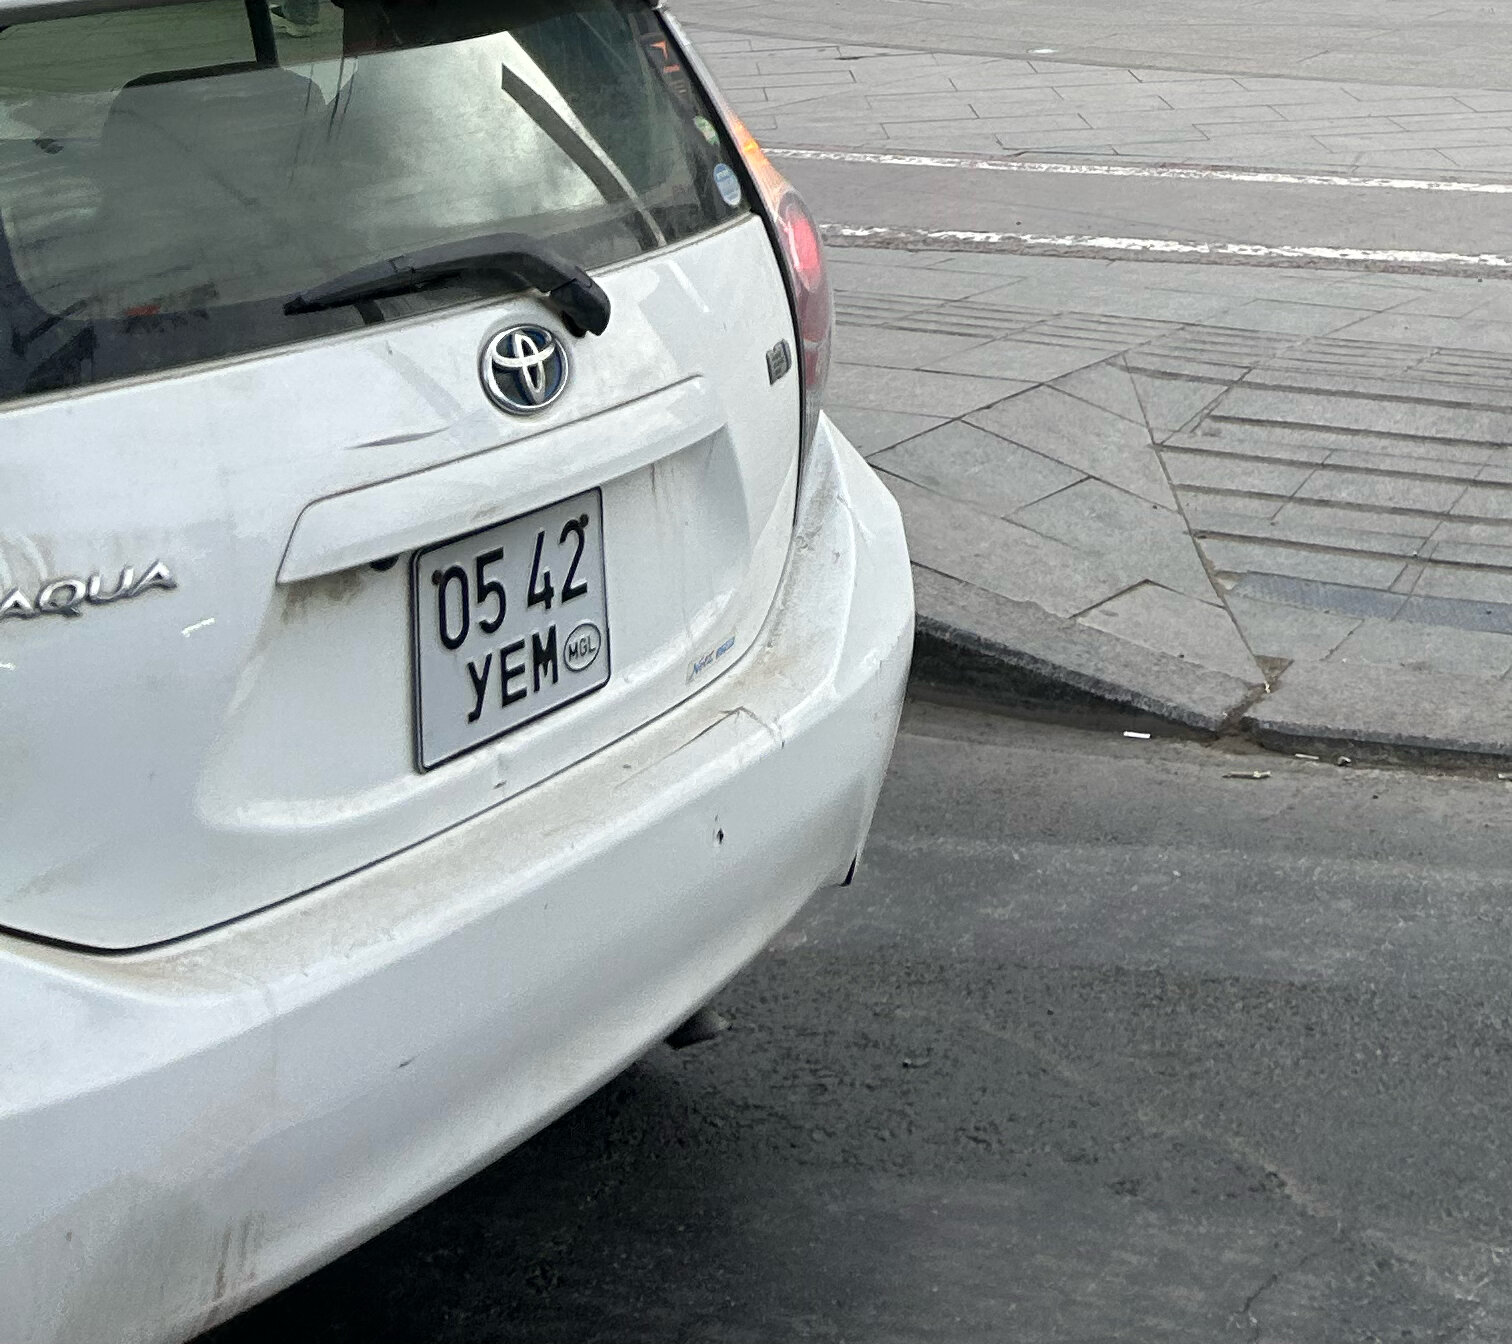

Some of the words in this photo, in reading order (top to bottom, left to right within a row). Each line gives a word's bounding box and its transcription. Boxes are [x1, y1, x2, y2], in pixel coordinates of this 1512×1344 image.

[0, 559, 178, 620] AQUA
[438, 546, 507, 650] 05
[527, 518, 588, 610] 42
[568, 636, 597, 660] MGL
